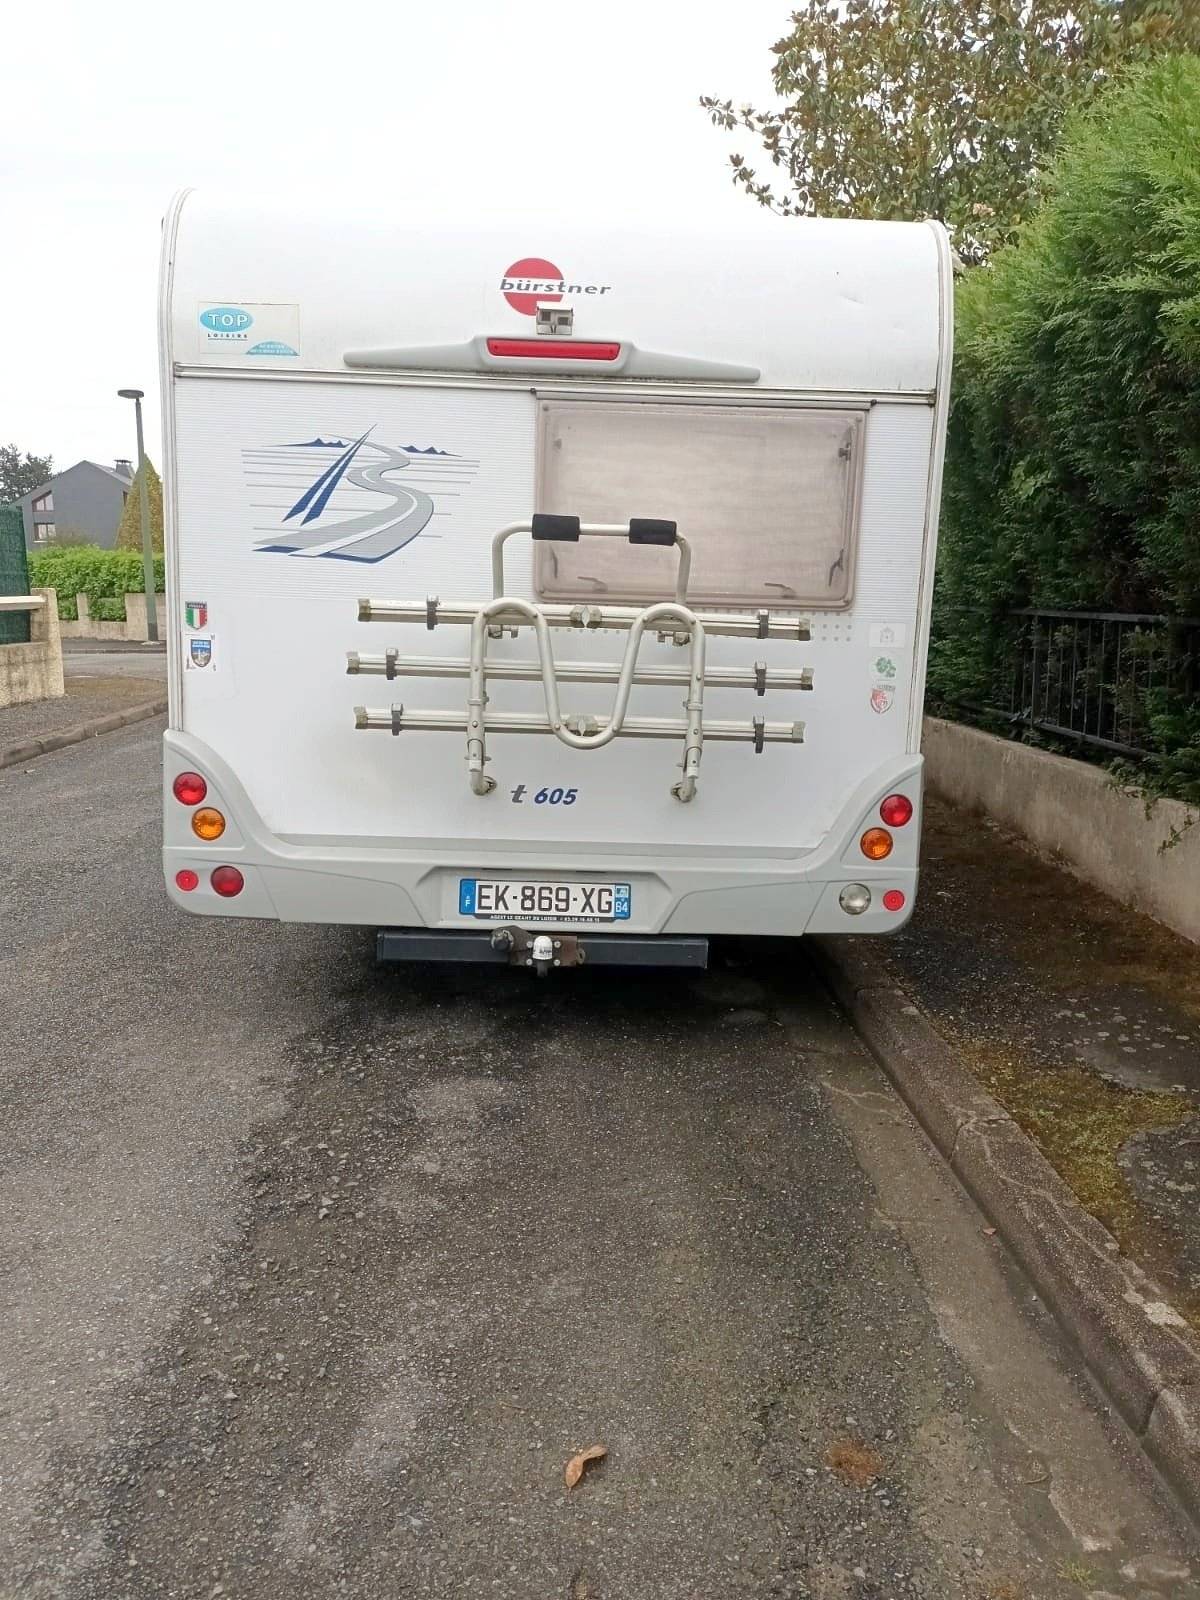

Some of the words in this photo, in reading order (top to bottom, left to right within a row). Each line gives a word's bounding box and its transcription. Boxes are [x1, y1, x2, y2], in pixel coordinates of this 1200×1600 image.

[499, 279, 612, 295] bürstner
[207, 314, 248, 327] TOP
[534, 787, 578, 805] 605
[465, 899, 471, 907] F
[477, 884, 613, 914] EK-869-XG
[615, 901, 628, 913] 64
